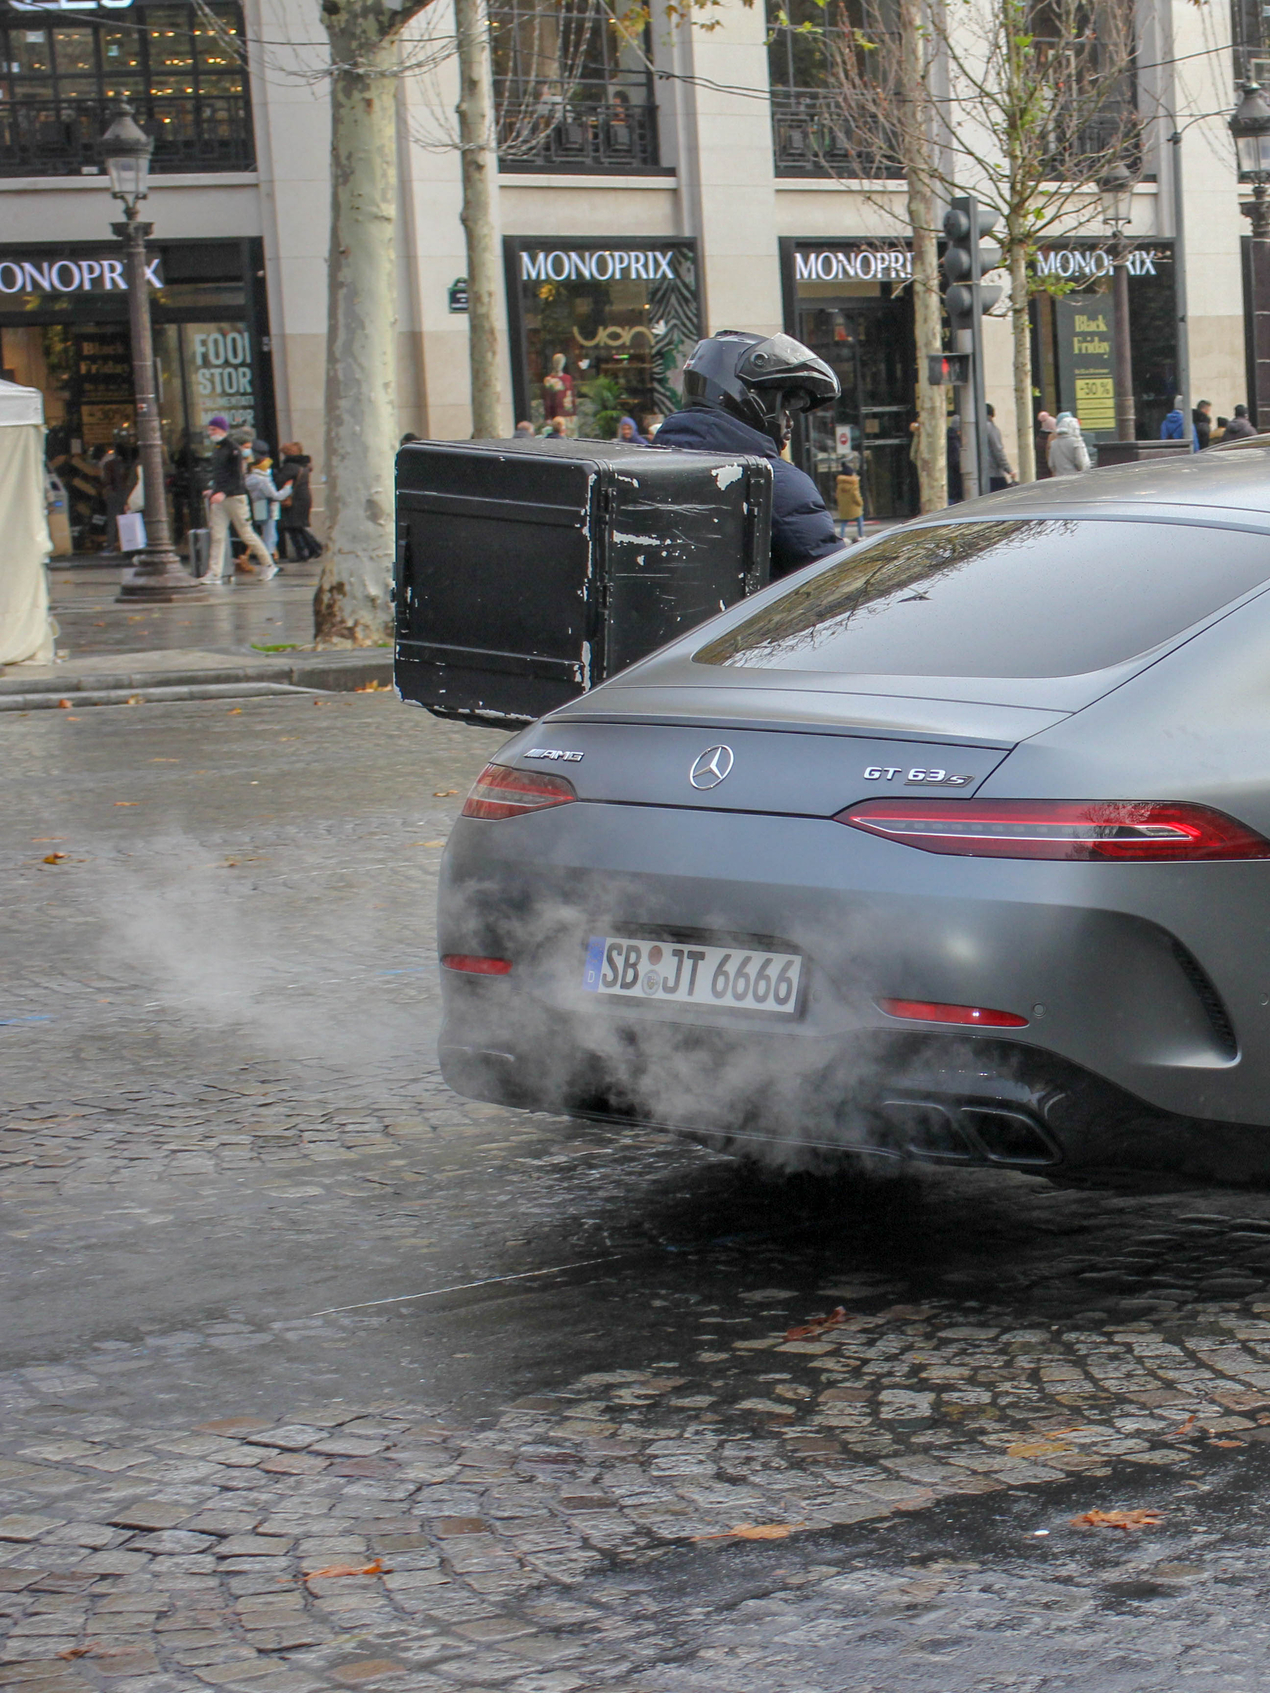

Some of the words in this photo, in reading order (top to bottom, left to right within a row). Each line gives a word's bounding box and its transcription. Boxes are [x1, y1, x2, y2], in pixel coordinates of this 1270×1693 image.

[0, 258, 164, 293] ONOPRX
[519, 251, 676, 281] MONOPRIX
[794, 251, 915, 280] MONOPRI
[1036, 250, 1157, 277] MONORIX
[1074, 314, 1108, 332] Black
[1073, 337, 1111, 358] Friday
[537, 748, 584, 762] AMG
[863, 766, 902, 781] GT
[587, 970, 596, 983] D
[601, 942, 642, 990] SB
[661, 948, 706, 996] JT
[711, 953, 795, 1006] 6666
